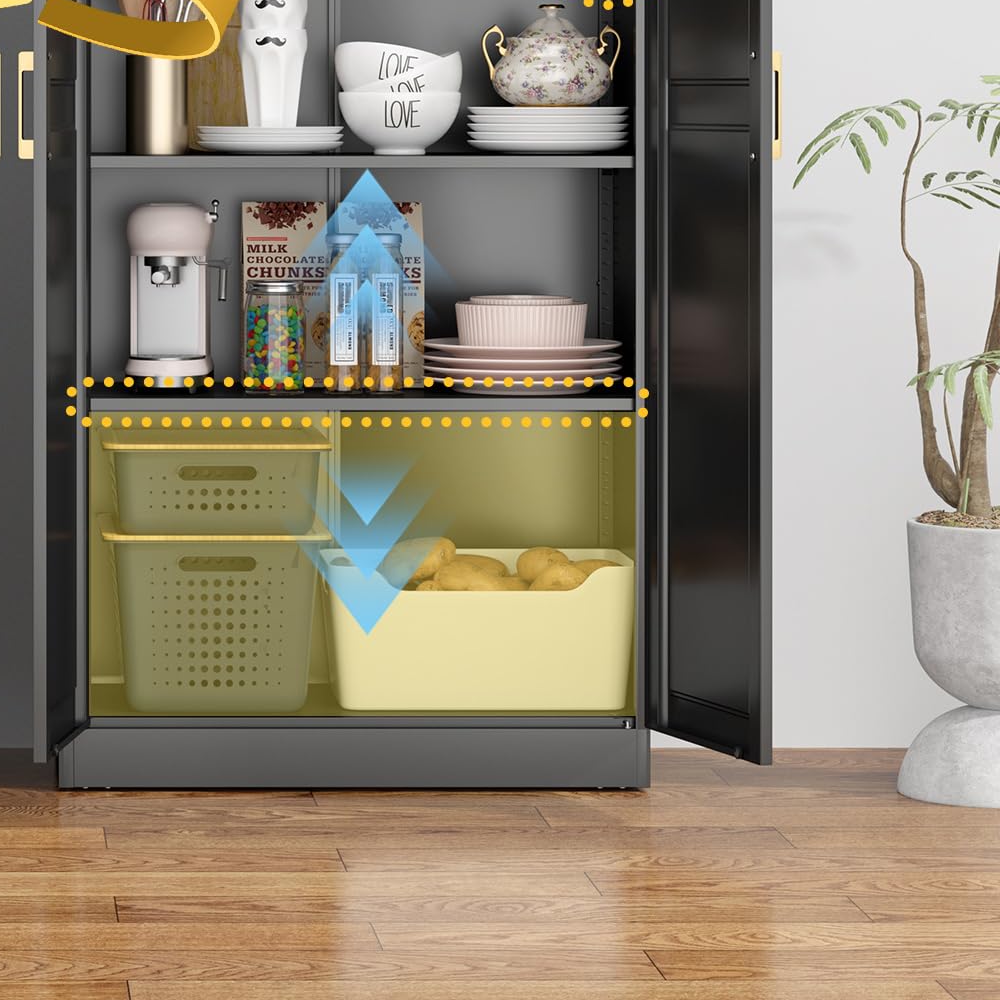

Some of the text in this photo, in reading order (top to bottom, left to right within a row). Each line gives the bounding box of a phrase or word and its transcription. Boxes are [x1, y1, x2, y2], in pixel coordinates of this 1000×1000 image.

[384, 99, 421, 129] LOVE
[246, 244, 288, 253] MILK
[246, 255, 326, 264] CHOCOLATE
[246, 266, 326, 279] CHUNKS
